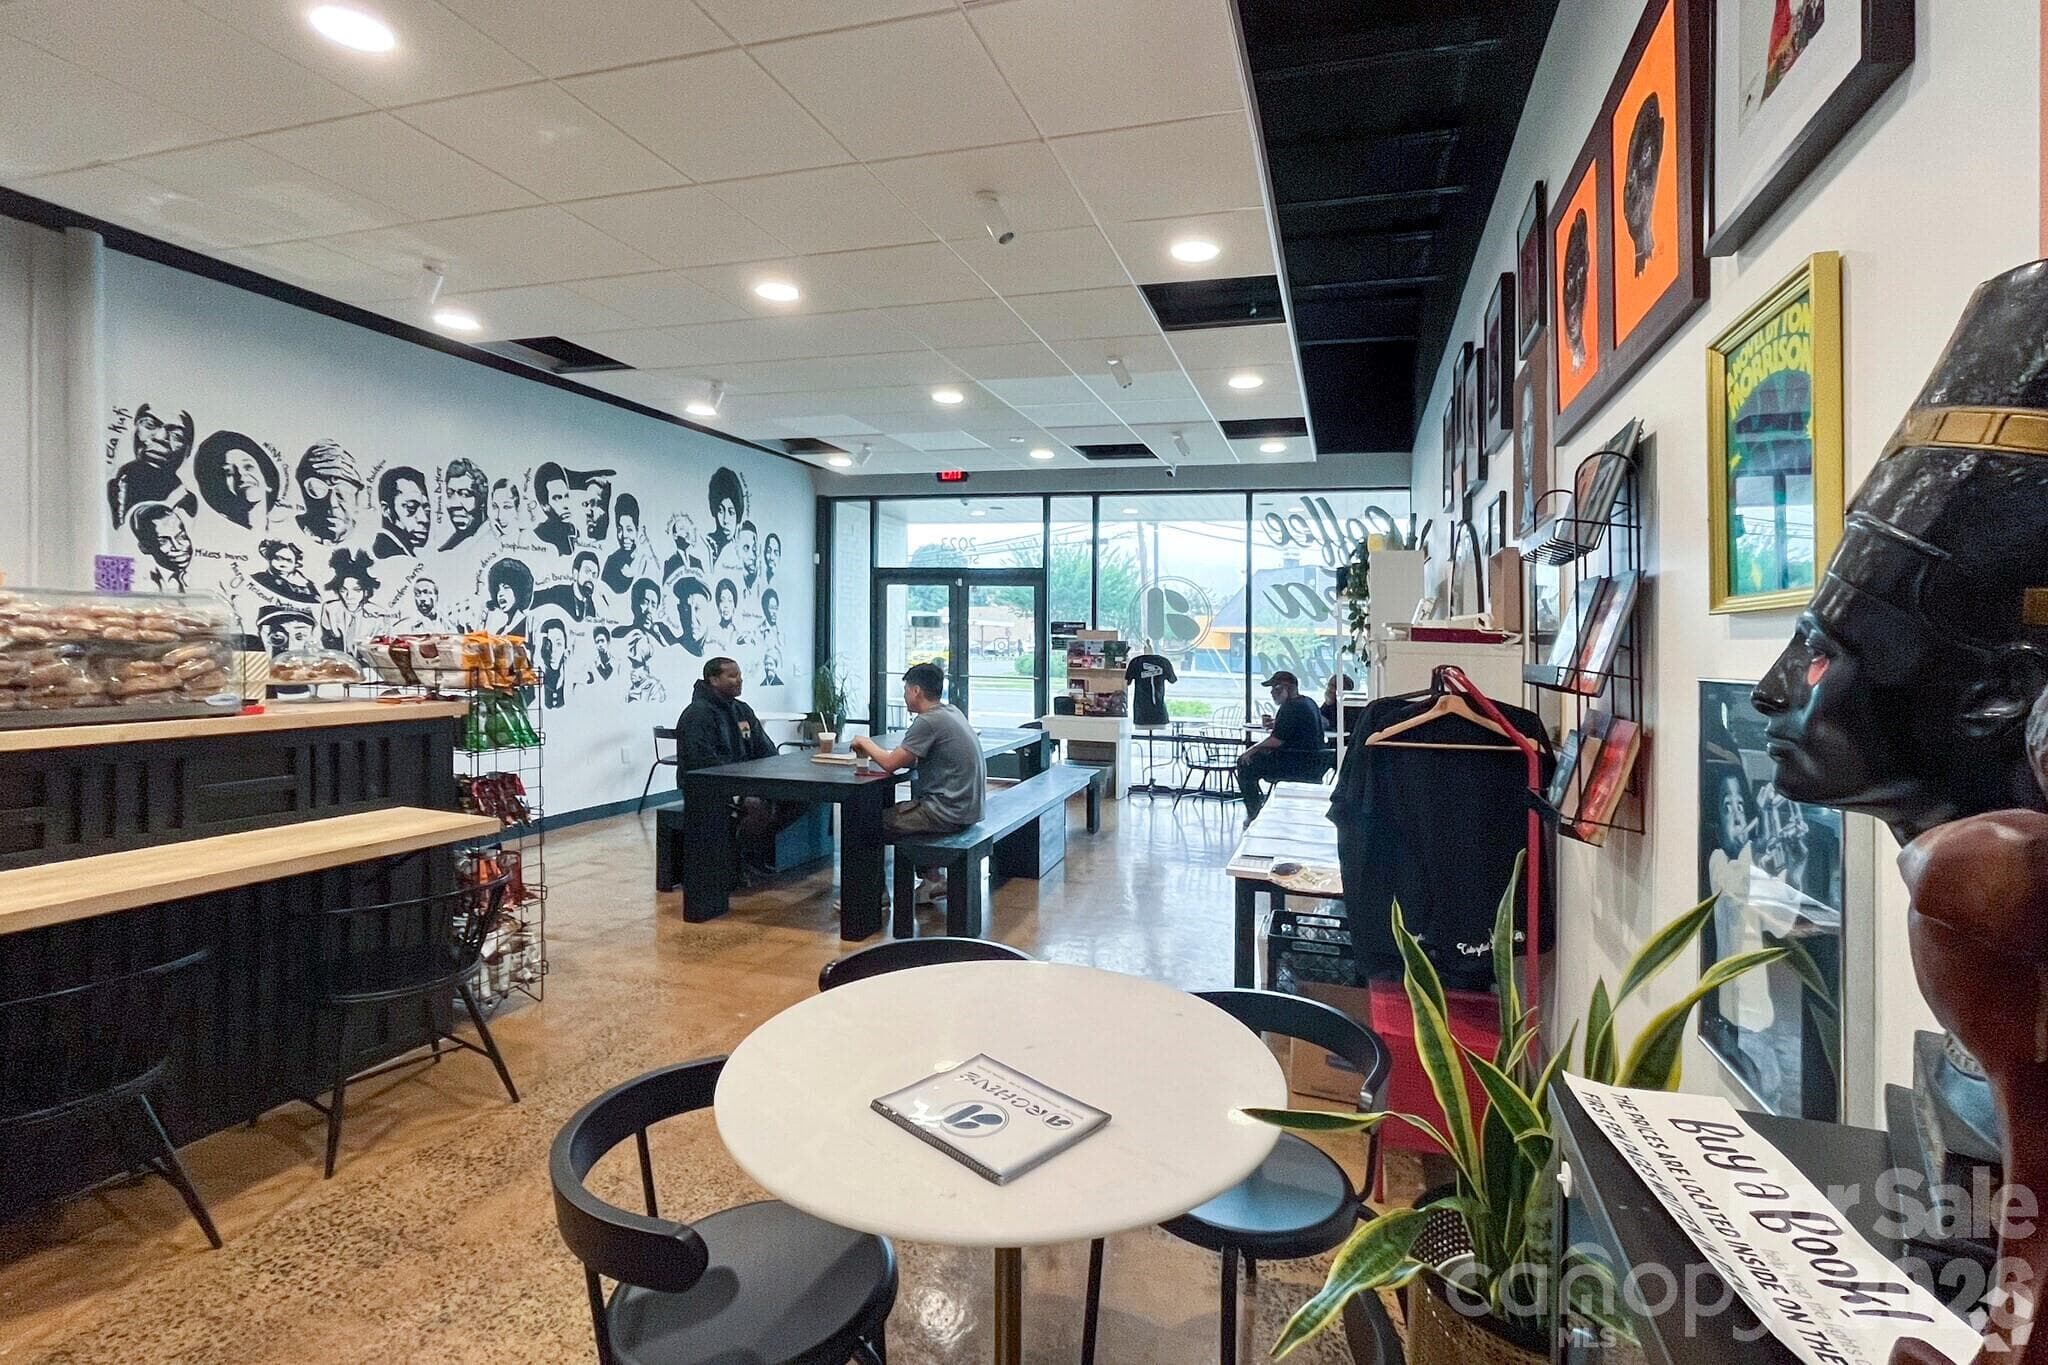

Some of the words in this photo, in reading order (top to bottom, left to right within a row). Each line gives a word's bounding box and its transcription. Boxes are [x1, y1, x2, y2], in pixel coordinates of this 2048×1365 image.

[1781, 303, 1811, 335] TON
[1581, 1091, 1616, 1121] FIRST
[1610, 1093, 1639, 1112] THE
[1624, 1112, 1669, 1149] PRICES
[1654, 1151, 1692, 1176] ARE
[1668, 1118, 1768, 1174] Buy
[1734, 1182, 1790, 1200] a
[1675, 1177, 1741, 1239] LOCATED
[1724, 1239, 1789, 1294] INSIDE
[1773, 1297, 1815, 1325] ON
[1797, 1329, 1851, 1365] THE
